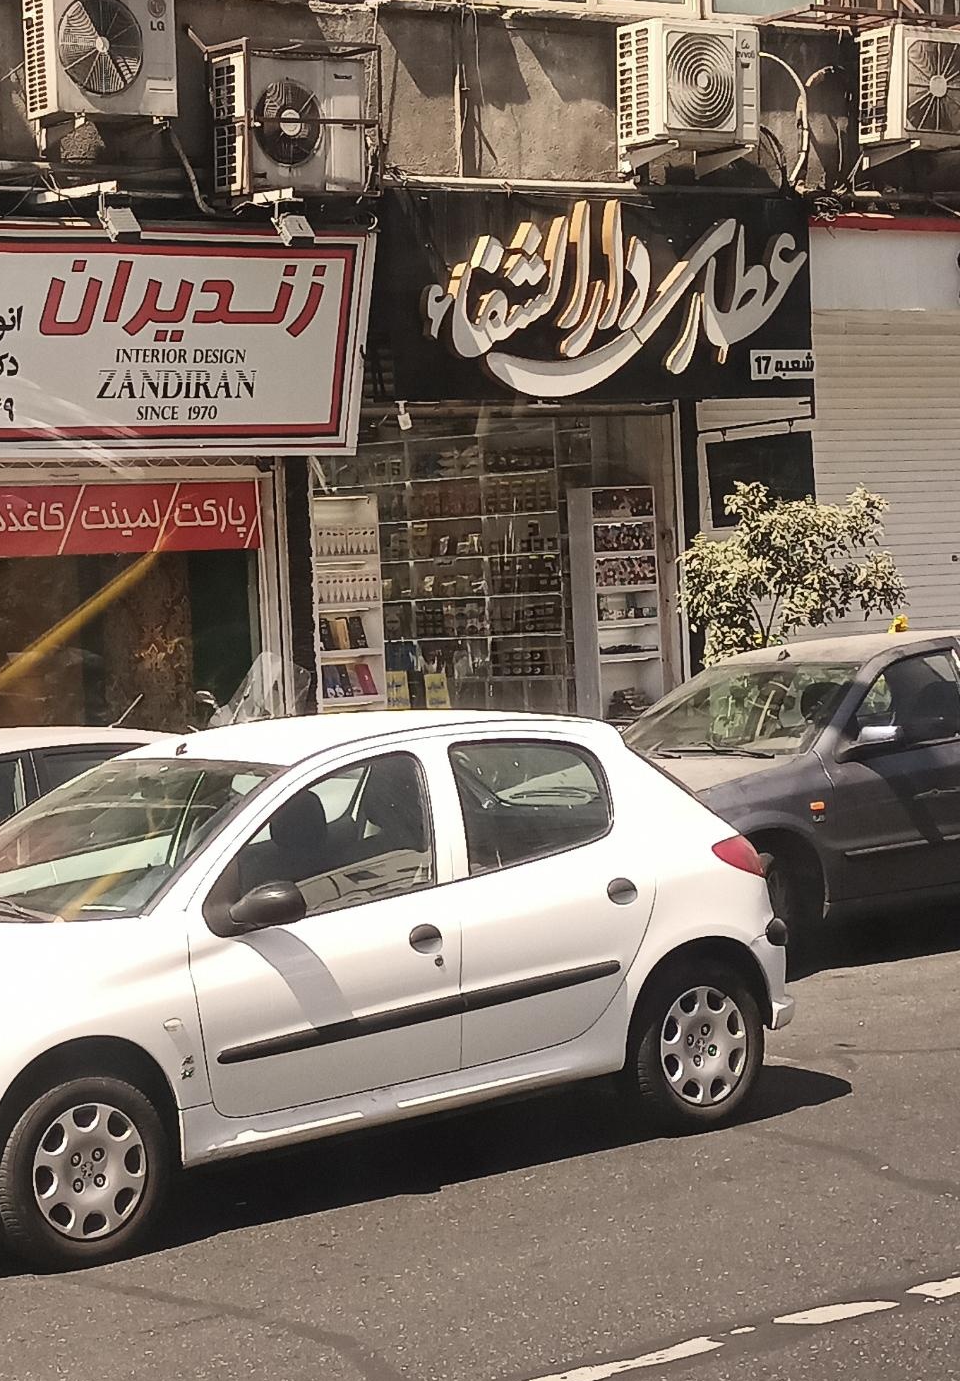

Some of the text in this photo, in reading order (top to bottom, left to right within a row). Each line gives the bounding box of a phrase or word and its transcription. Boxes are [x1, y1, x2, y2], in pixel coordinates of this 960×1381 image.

[149, 20, 166, 32] LG
[39, 259, 327, 343] زندیران
[115, 348, 247, 364] INTERIOR DESIGN
[754, 353, 814, 377] شعبه 17
[96, 369, 258, 399] ZANDIRAN
[136, 405, 218, 421] SINCE 1970
[80, 497, 161, 540] لمینت
[171, 497, 248, 540] پارکت
